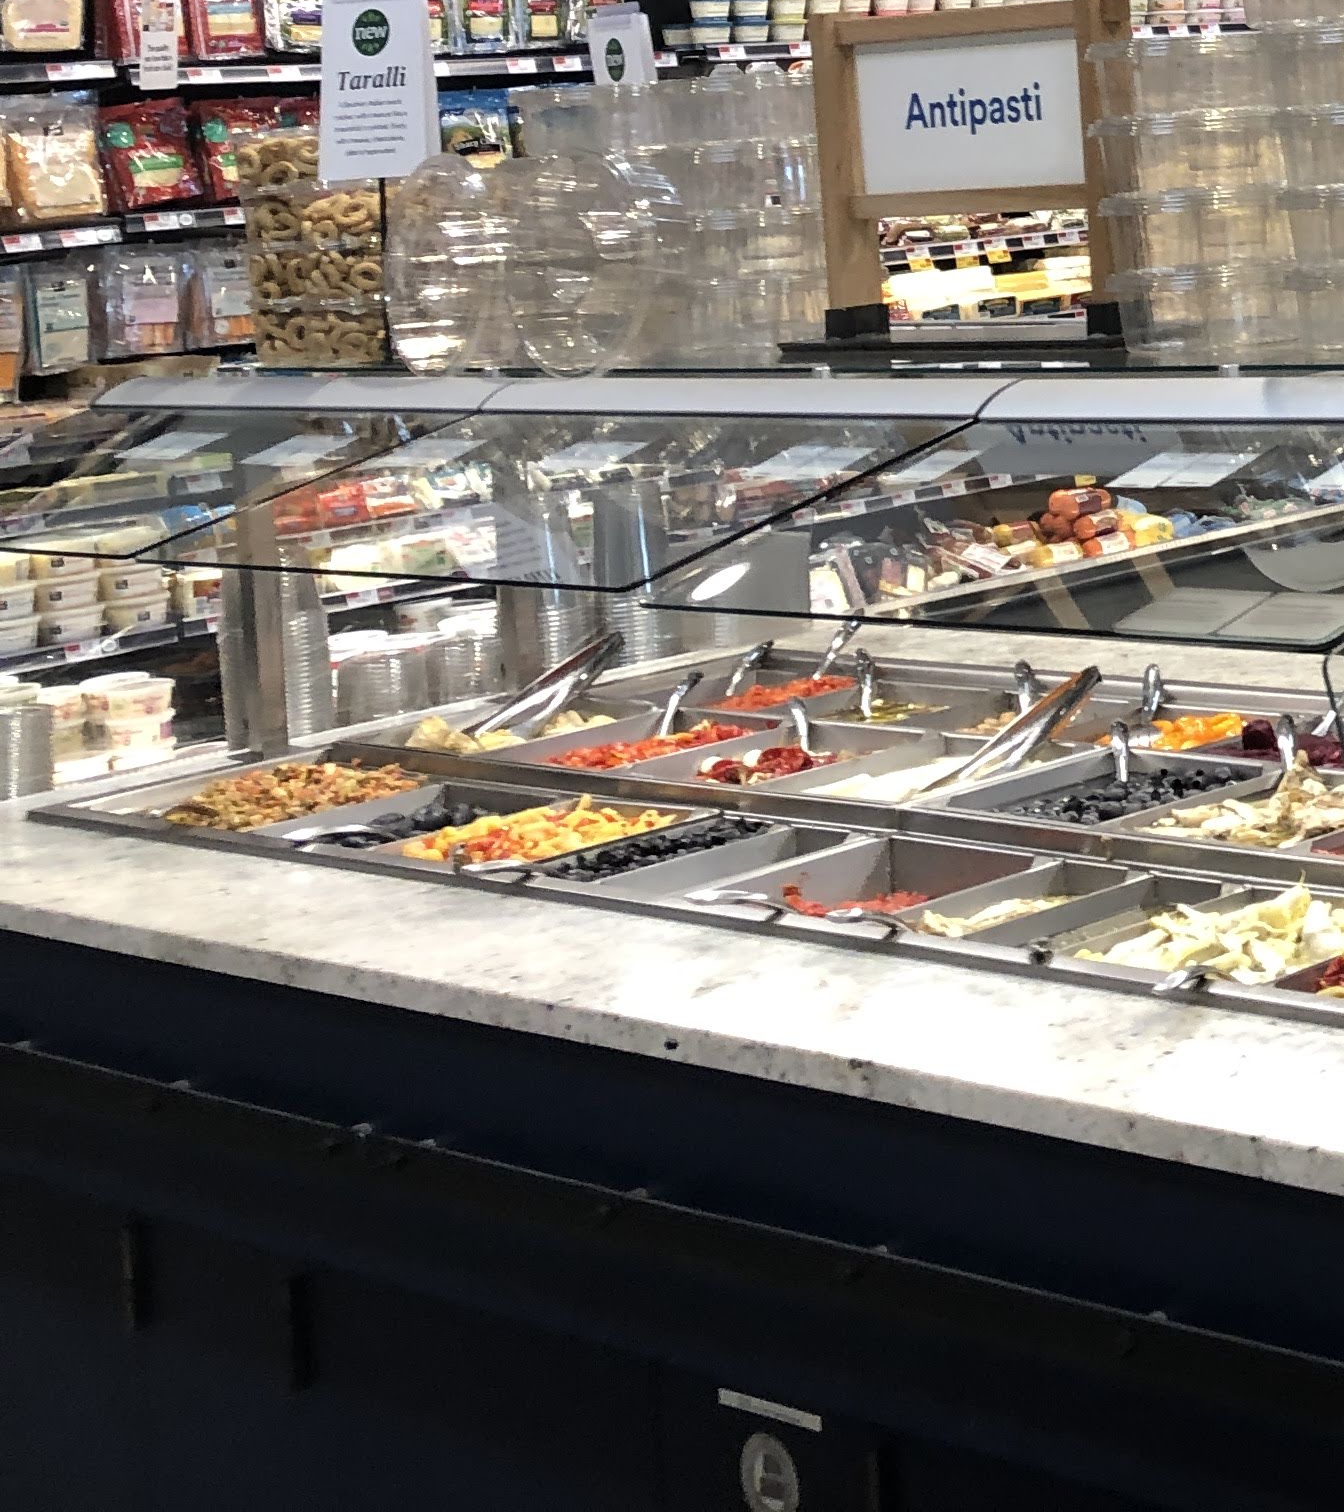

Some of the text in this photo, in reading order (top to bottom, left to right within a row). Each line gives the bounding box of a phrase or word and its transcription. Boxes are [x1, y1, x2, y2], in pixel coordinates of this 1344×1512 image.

[354, 25, 388, 40] new
[337, 66, 407, 91] Taralli
[904, 82, 1042, 136] Antipasti
